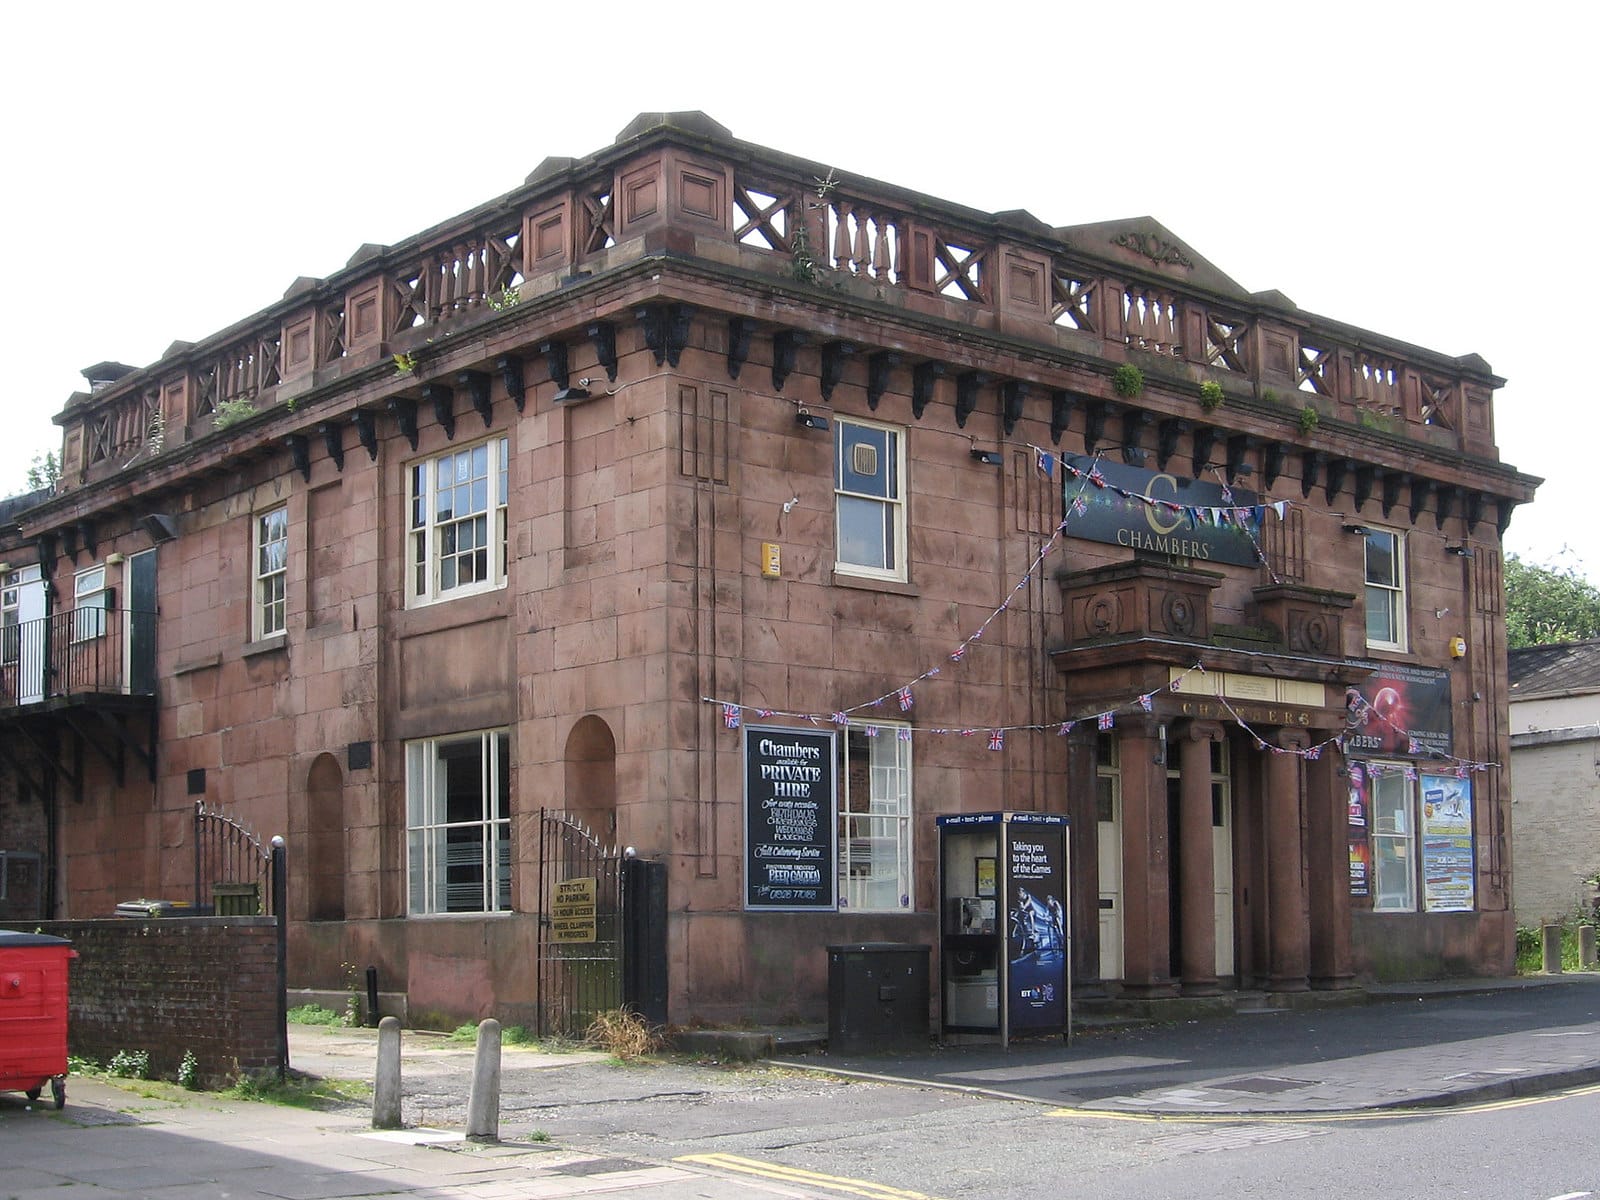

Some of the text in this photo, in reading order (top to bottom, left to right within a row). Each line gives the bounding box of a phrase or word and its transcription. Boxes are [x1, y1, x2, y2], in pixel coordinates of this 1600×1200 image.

[1117, 528, 1209, 560] CHAMBERS
[760, 739, 820, 759] Chambers
[760, 765, 821, 782] PRIVATE
[774, 782, 811, 798] HIRE
[978, 814, 994, 823] phone
[1013, 814, 1029, 822] e-mail
[1045, 816, 1061, 824] phone
[775, 825, 814, 835] WEDDINGS
[774, 833, 813, 842] FUNERALS
[1012, 841, 1044, 853] Taking you
[1012, 853, 1047, 863] to the heart
[1012, 863, 1051, 874] of the Games
[769, 869, 820, 884] BEER GARDEN
[560, 883, 585, 893] STRICTLY
[557, 893, 590, 903] NO PARKING
[560, 908, 574, 917] HOUR
[575, 907, 594, 916] ACCESS
[554, 921, 594, 930] WHEEL CLAMPING
[558, 930, 589, 939] IN PROGRESS
